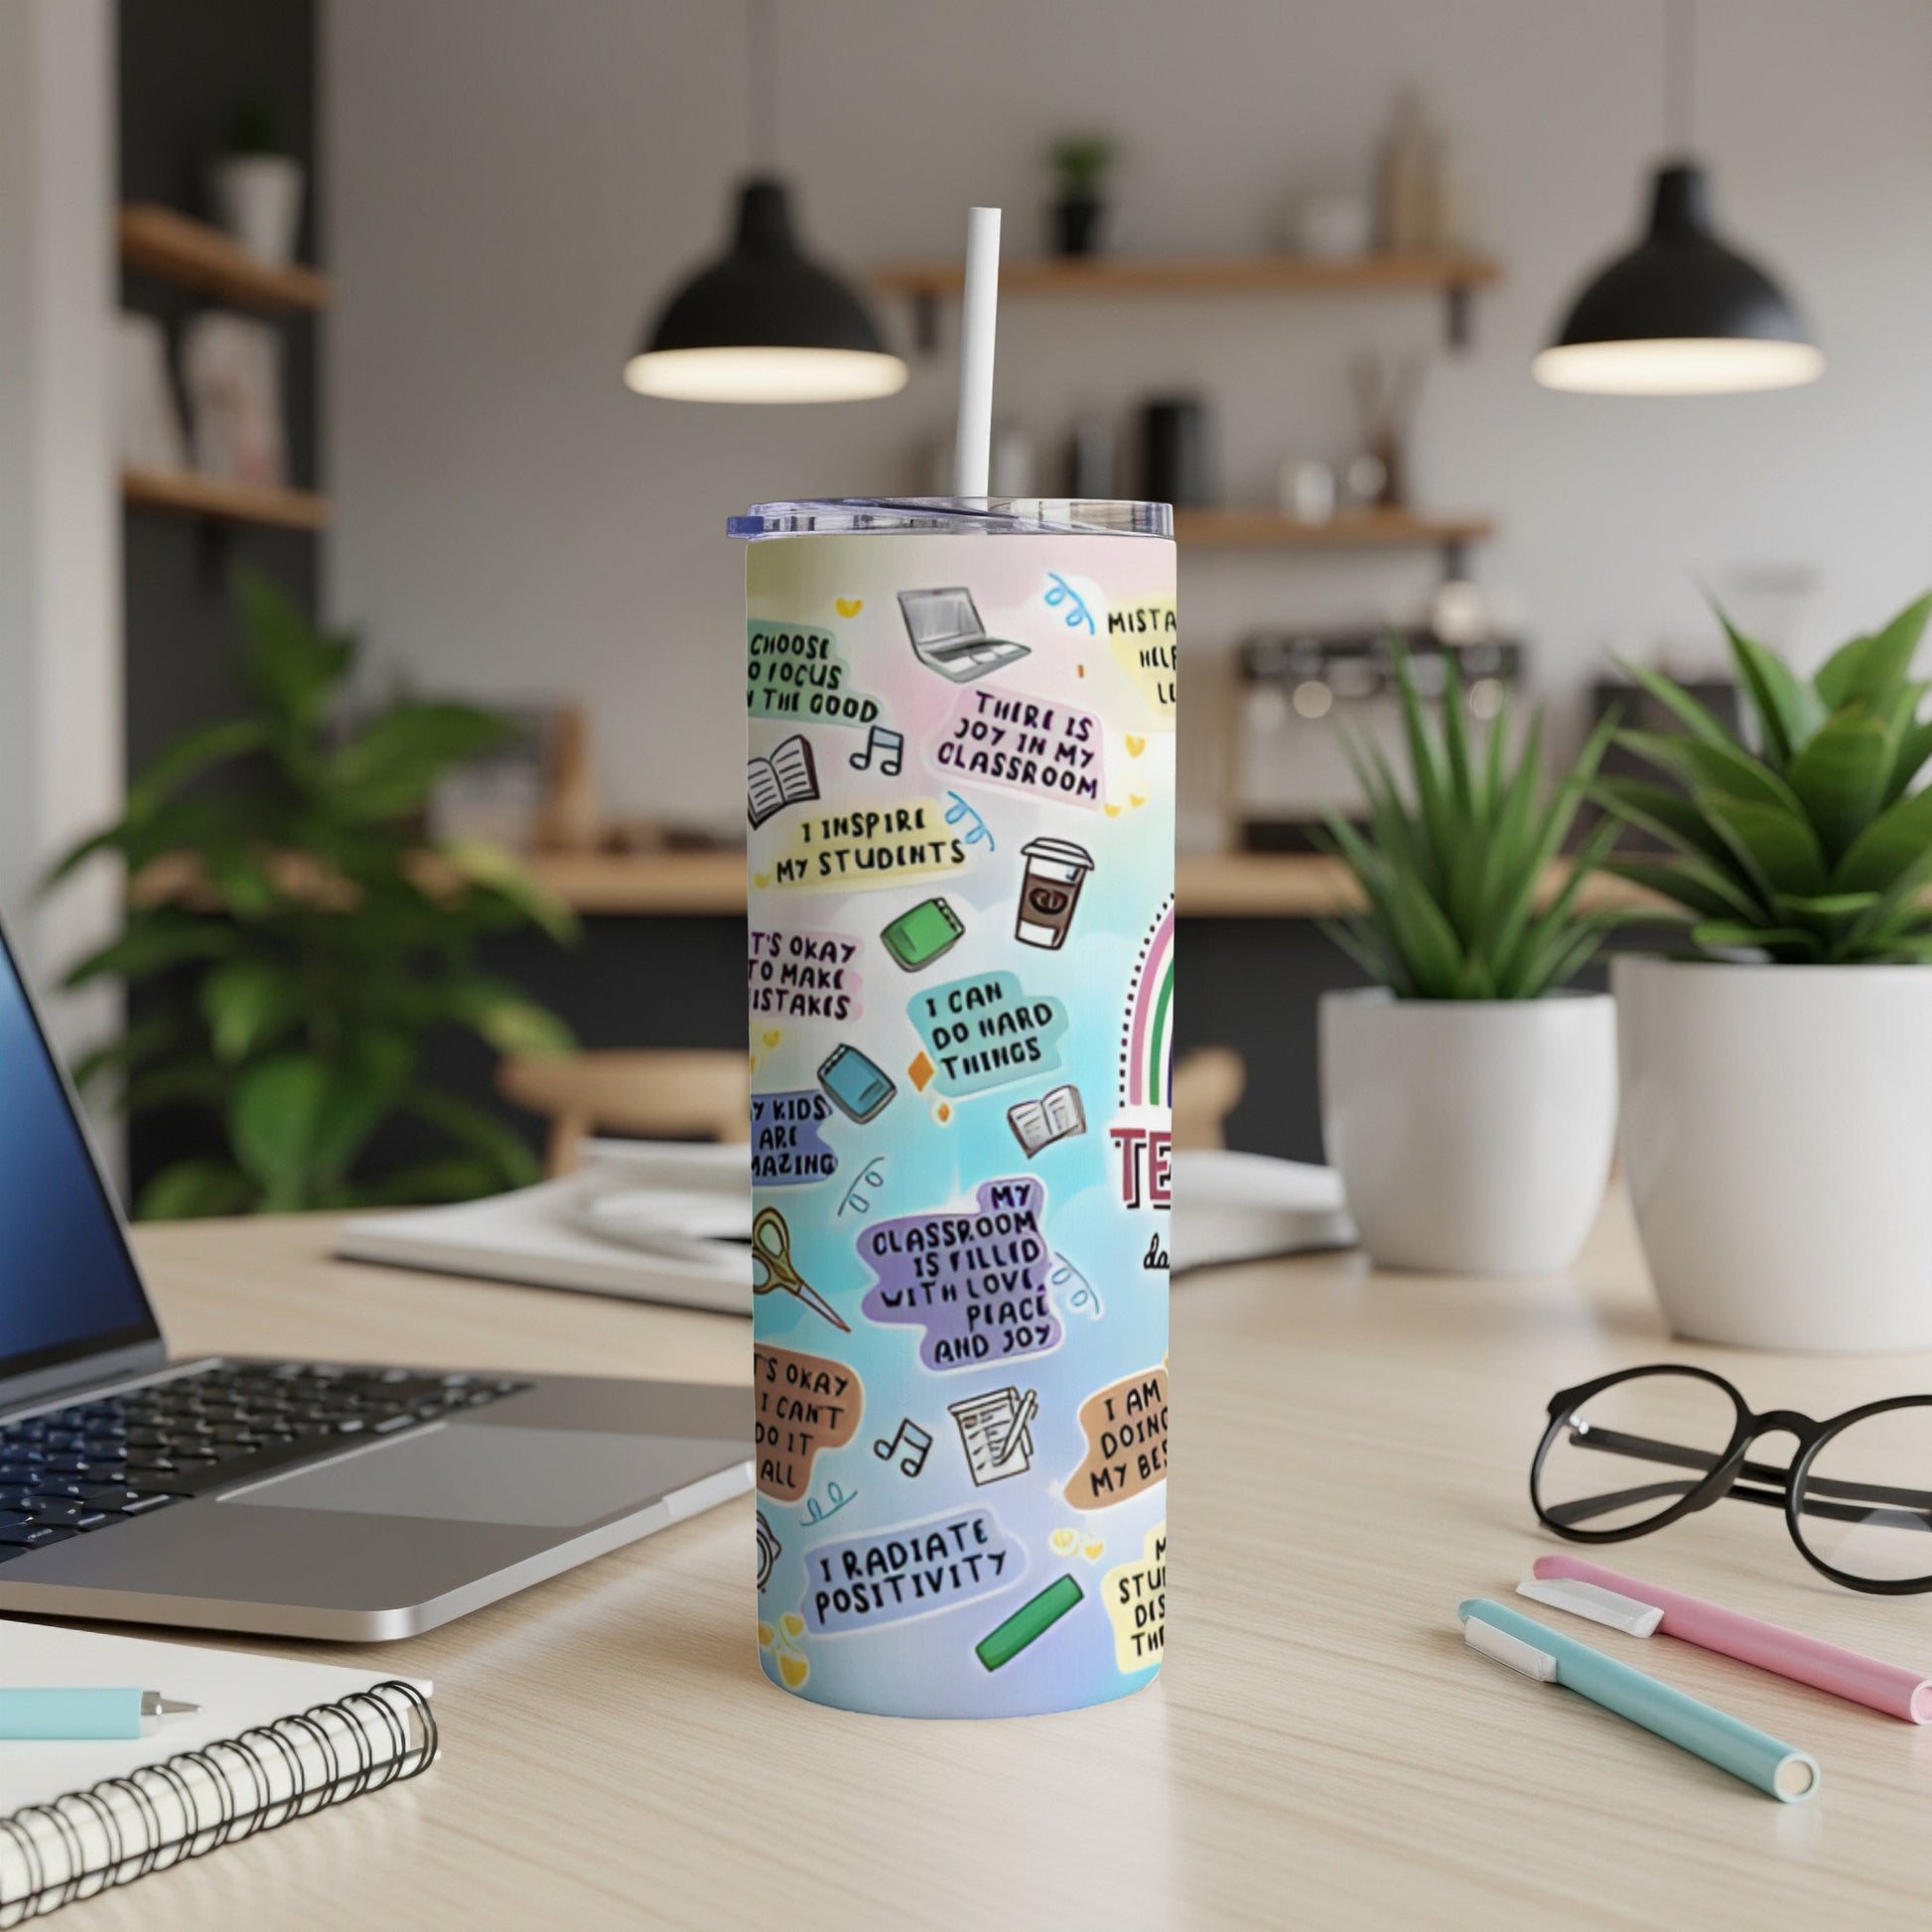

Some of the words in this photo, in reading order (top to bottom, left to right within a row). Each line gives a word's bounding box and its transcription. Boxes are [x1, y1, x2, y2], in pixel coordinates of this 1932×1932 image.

[751, 633, 829, 659] CHOOSE
[762, 688, 800, 712] THE
[810, 693, 879, 723] GOOD
[976, 690, 1054, 731] THERE
[1065, 717, 1093, 742] IS
[953, 718, 1006, 747] JOY
[1017, 733, 1046, 756] IN
[1054, 743, 1094, 768] MY
[938, 742, 1098, 799] CLASSROOM
[801, 823, 810, 842] I
[822, 808, 925, 840] INSPIRE
[777, 859, 807, 883] MY
[819, 838, 965, 876] STUDENTS
[789, 935, 856, 963] OKAY
[749, 959, 772, 981] TO
[781, 963, 844, 990] MAKE
[925, 998, 937, 1018] I
[948, 981, 1003, 1014] CAN
[932, 1022, 969, 1051] DO
[979, 1003, 1052, 1038] HARD
[940, 1036, 1041, 1080] THINGS
[772, 1094, 827, 1121] KIDS
[759, 1126, 797, 1150] ARE
[991, 1184, 1031, 1209] MY
[872, 1211, 1038, 1256] CLASSROOM
[913, 1252, 939, 1278] IS
[950, 1238, 1039, 1271] FILLED
[881, 1282, 957, 1308] WITH
[967, 1296, 1048, 1332] PEACE
[934, 1334, 989, 1363] AND
[1003, 1324, 1050, 1353] JOY
[786, 1363, 848, 1397] OKAY
[762, 1392, 768, 1412] I
[1104, 1397, 1114, 1422] I
[1127, 1378, 1161, 1416] AM
[756, 1422, 778, 1446] DO
[788, 1433, 813, 1455] IT
[760, 1459, 796, 1488] ALL
[1090, 1462, 1126, 1497] MY
[820, 1558, 831, 1583] I
[842, 1518, 988, 1581] RADIATE
[815, 1551, 1007, 1625] POSITIVITY
[1119, 1567, 1166, 1604] STU
